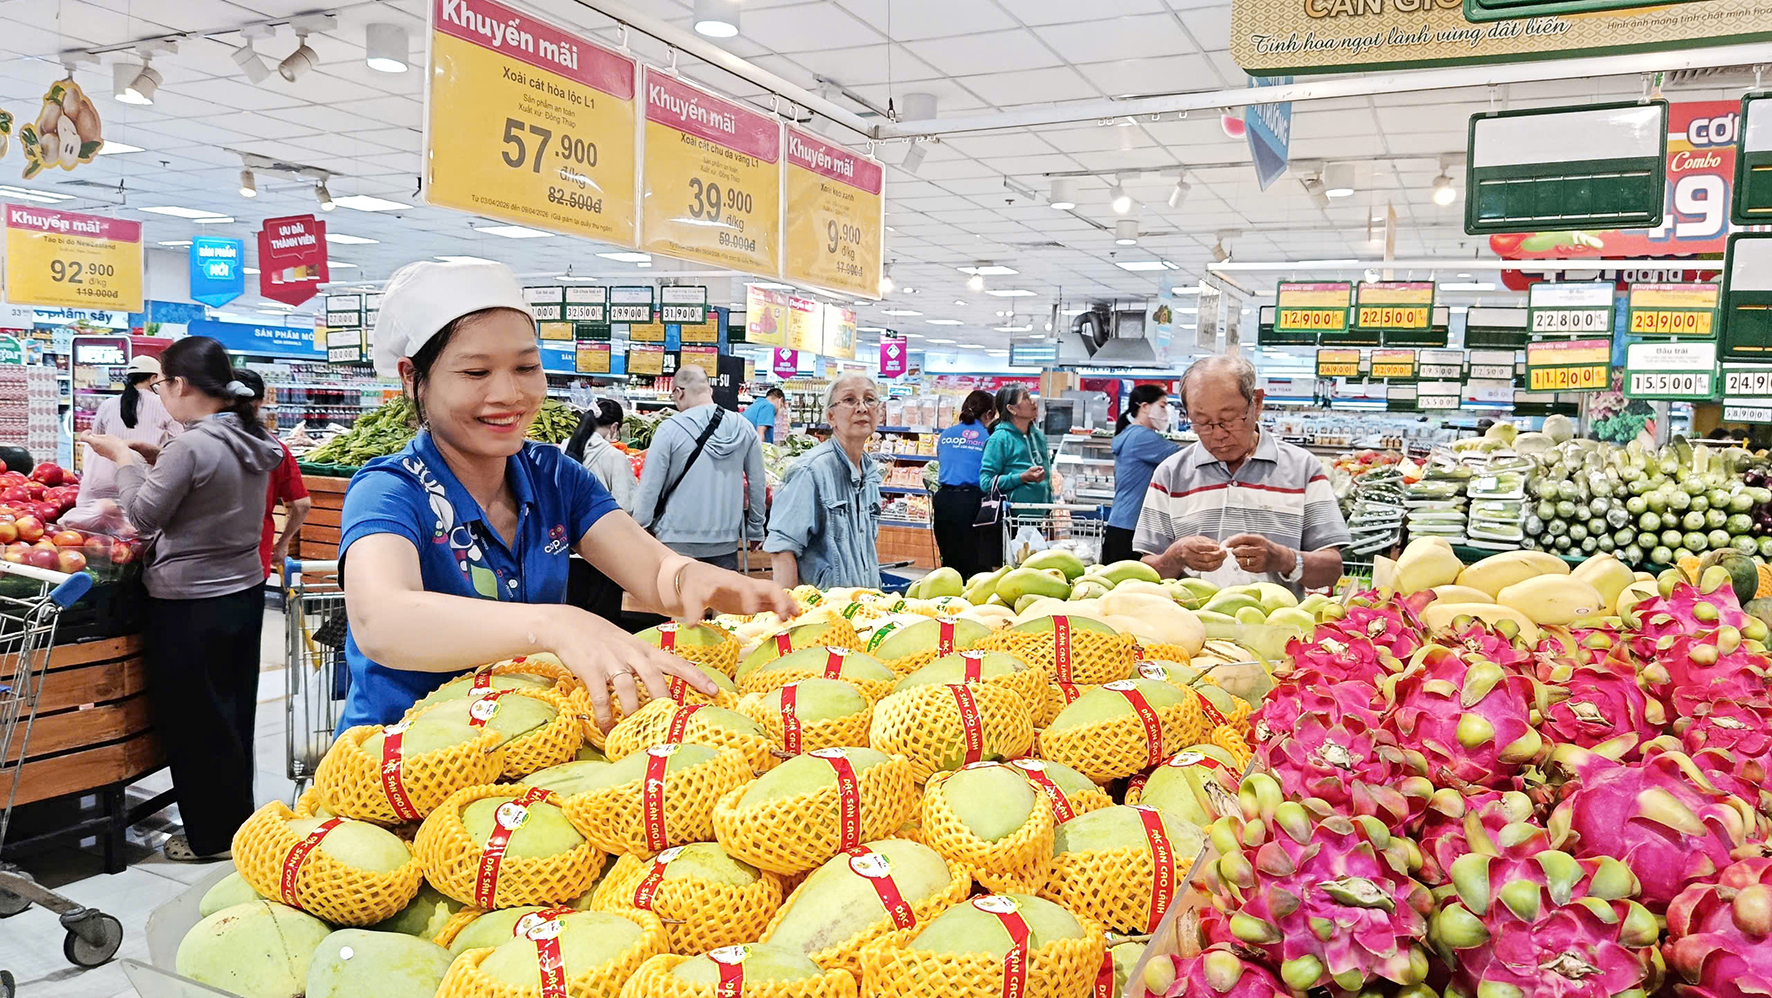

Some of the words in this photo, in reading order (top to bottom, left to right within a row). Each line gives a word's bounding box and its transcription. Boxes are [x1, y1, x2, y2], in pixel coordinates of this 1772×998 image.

[443, 0, 534, 53] Khuyến
[539, 42, 578, 70] mãi
[1303, 32, 1338, 53] hoa
[1340, 36, 1383, 54] ngọt
[1386, 24, 1432, 46] lành
[1436, 27, 1484, 46] vùng
[503, 66, 527, 86] Xoài
[529, 78, 545, 92] cát
[547, 82, 566, 99] hòa
[567, 91, 582, 106] lộc
[584, 98, 595, 109] L1
[649, 83, 707, 121] Khuyến
[710, 112, 735, 134] mãi
[789, 136, 832, 170] Khuyến
[833, 158, 854, 178] mãi
[1671, 151, 1722, 172] Combo
[11, 210, 70, 232] Khuyến
[73, 221, 101, 234] mãi
[1283, 311, 1331, 325] 12.900
[1362, 311, 1414, 323] 22.500
[1536, 313, 1594, 327] 22.800
[1635, 315, 1695, 328] 23.900
[1535, 369, 1592, 384] 11.200
[1635, 377, 1693, 390] 15.500
